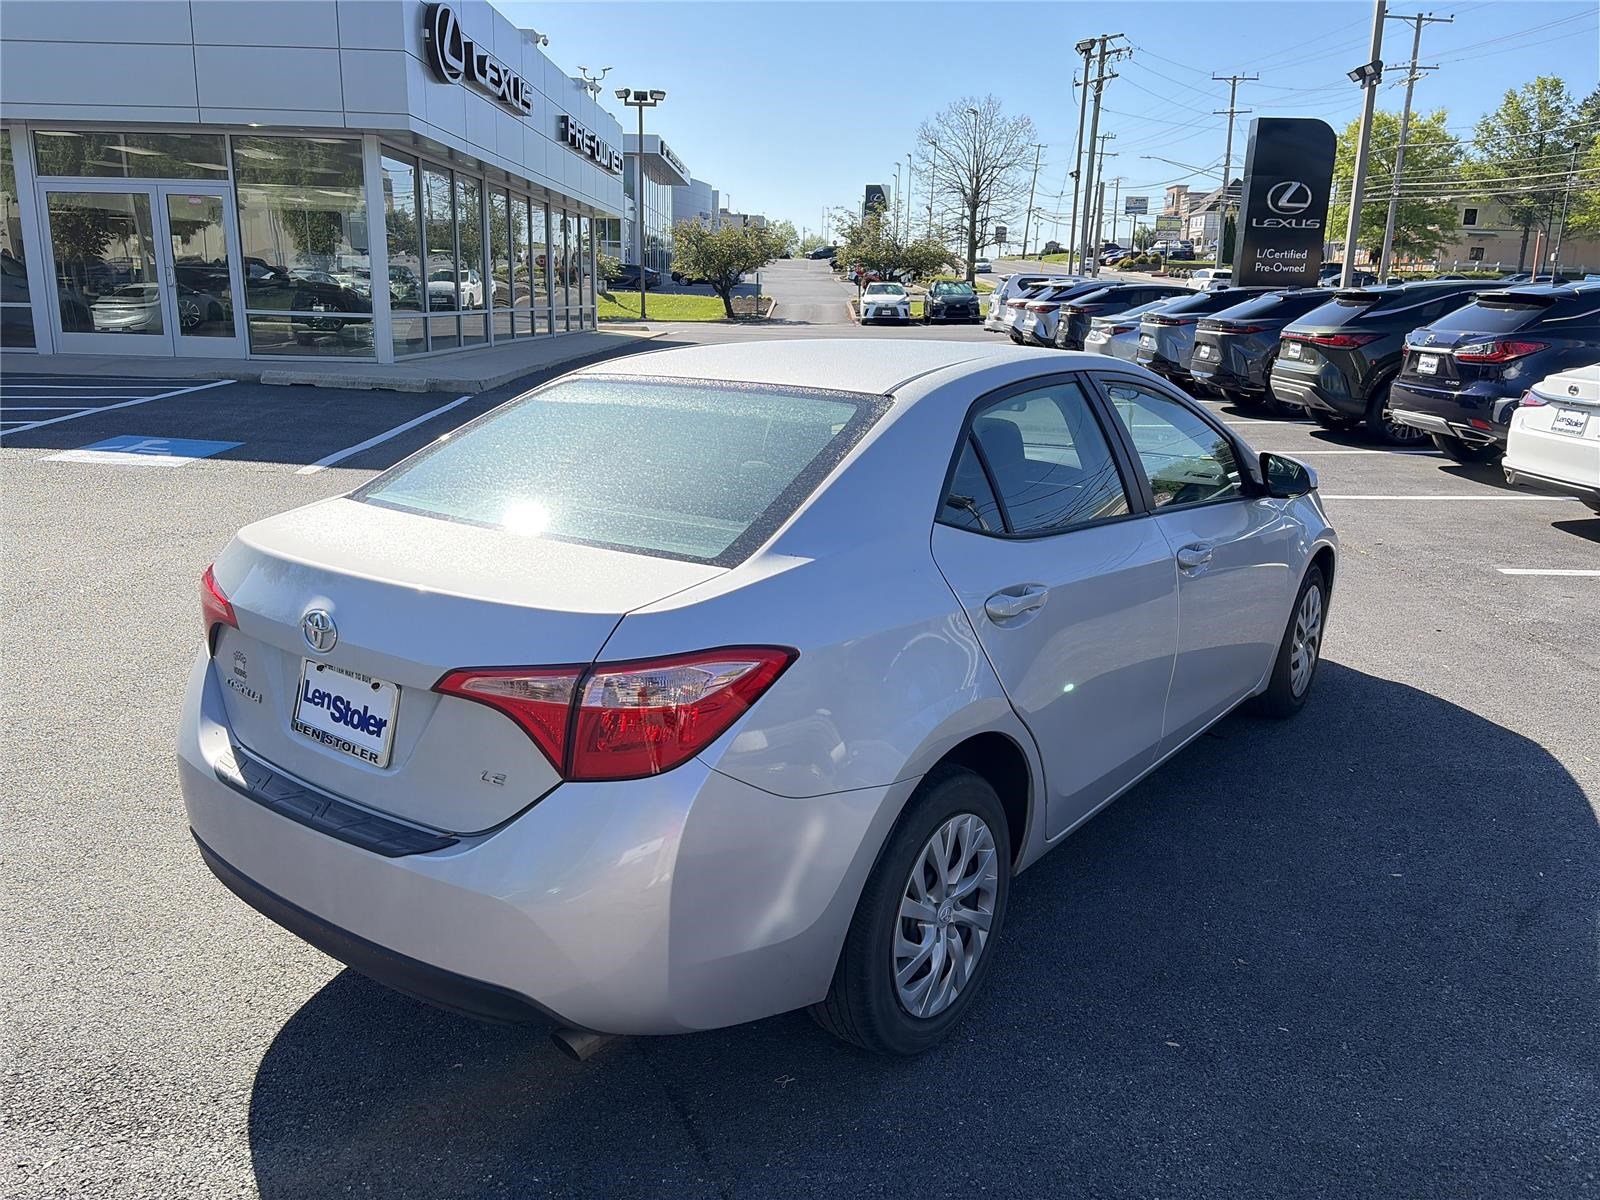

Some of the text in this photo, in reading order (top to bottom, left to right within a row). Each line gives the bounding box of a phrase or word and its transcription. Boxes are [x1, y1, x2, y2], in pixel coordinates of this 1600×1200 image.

[464, 40, 533, 117] LEXUS
[562, 114, 624, 175] PRE-OWNED
[1252, 218, 1321, 229] LEXUS
[1256, 248, 1308, 259] L/Certified
[1254, 262, 1306, 273] Pre-Owned
[295, 722, 379, 764] LEN STOLER
